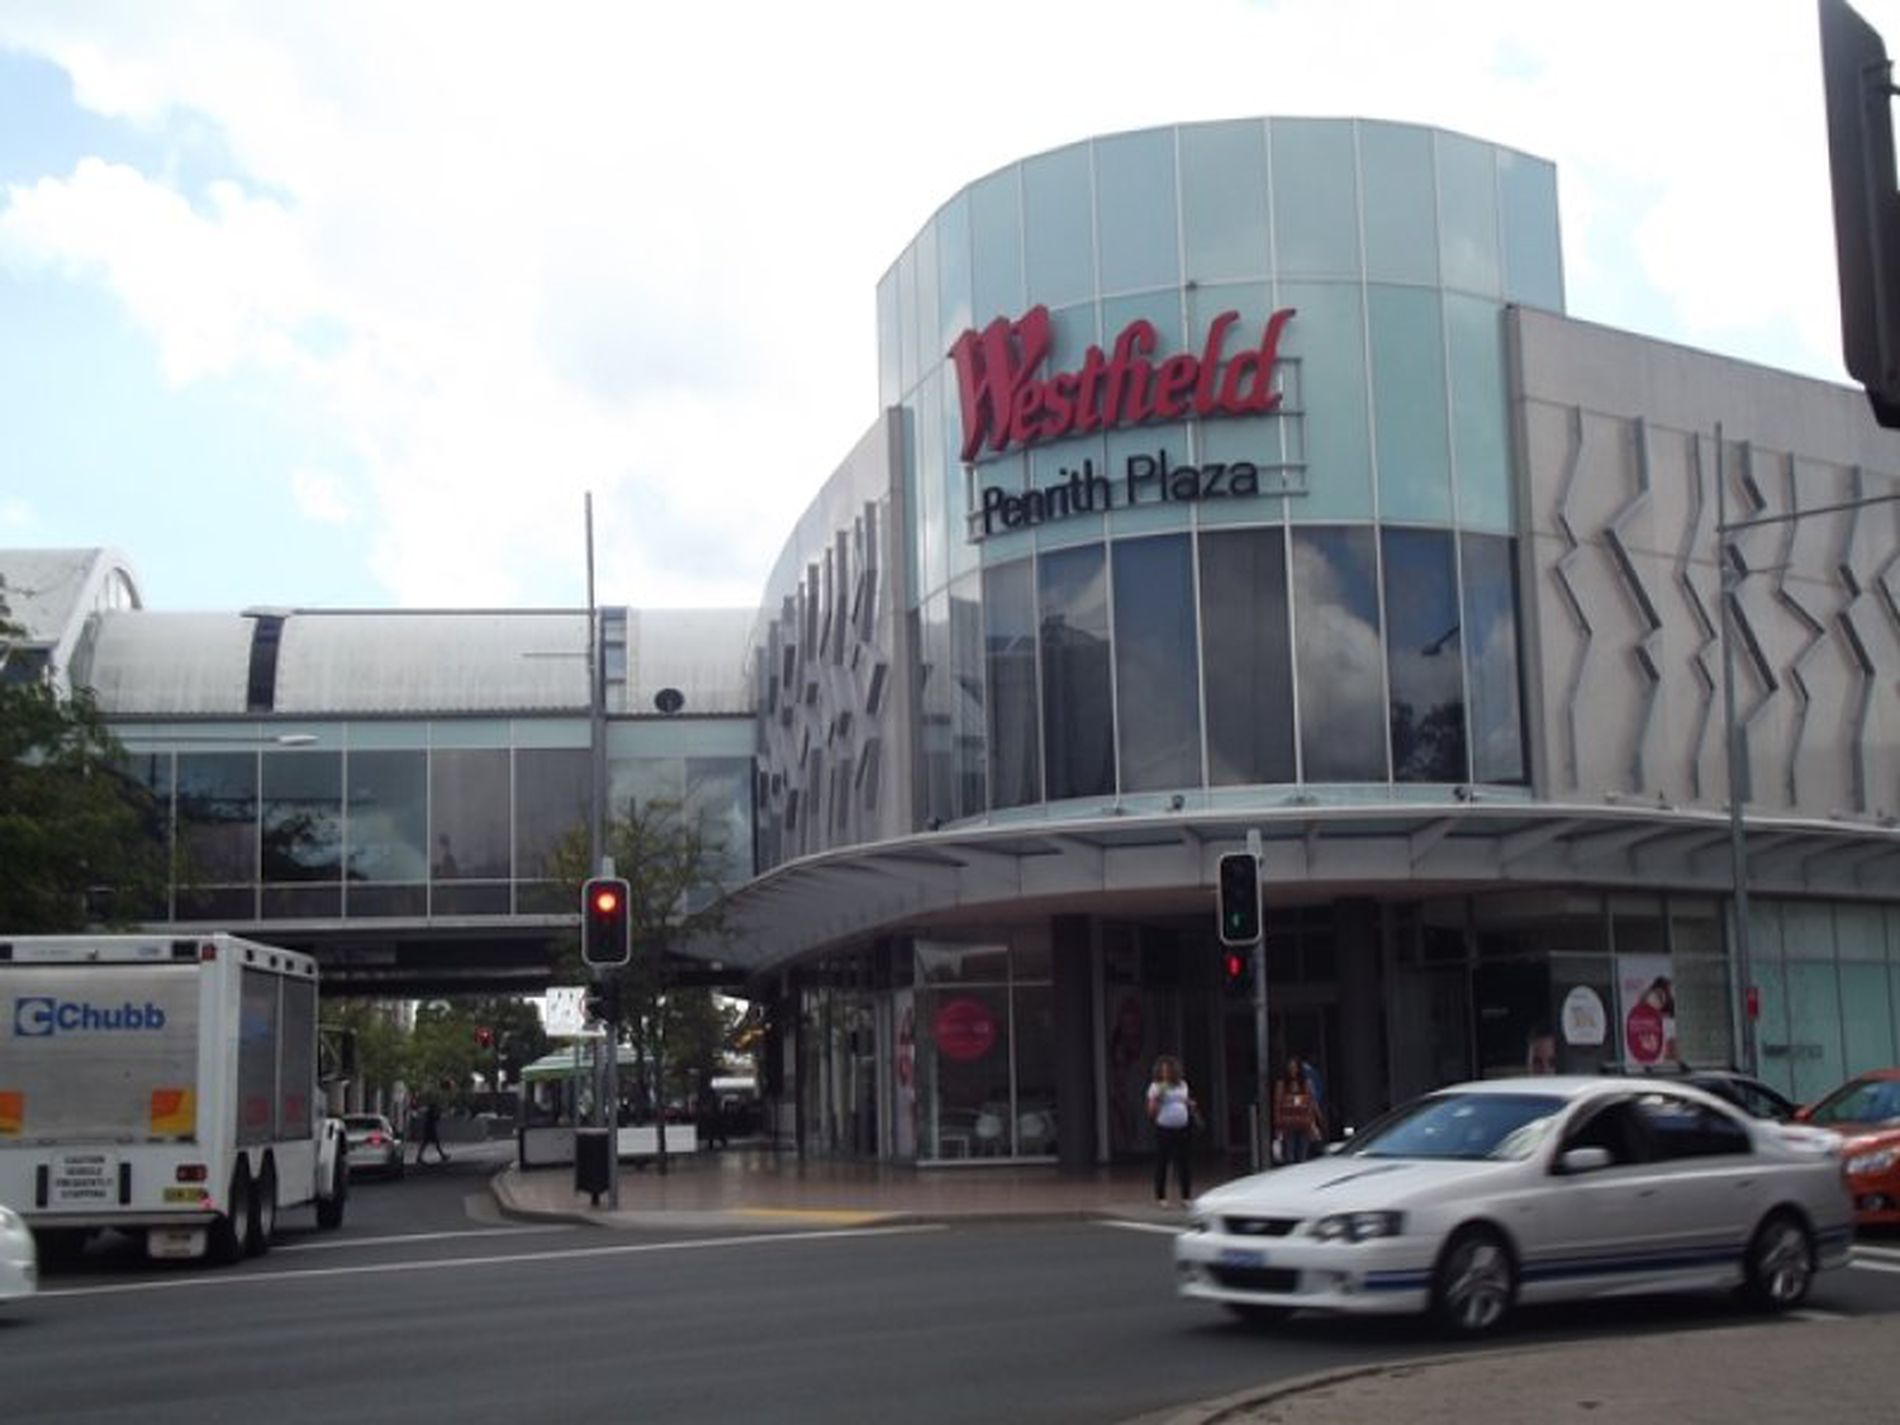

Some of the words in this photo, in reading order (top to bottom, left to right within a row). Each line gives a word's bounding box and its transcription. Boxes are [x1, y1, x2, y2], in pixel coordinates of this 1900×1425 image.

[948, 304, 1296, 462] Westfield
[982, 458, 1110, 534] Penrith
[1127, 449, 1259, 504] Plaza
[57, 1002, 166, 1030] Chubb
